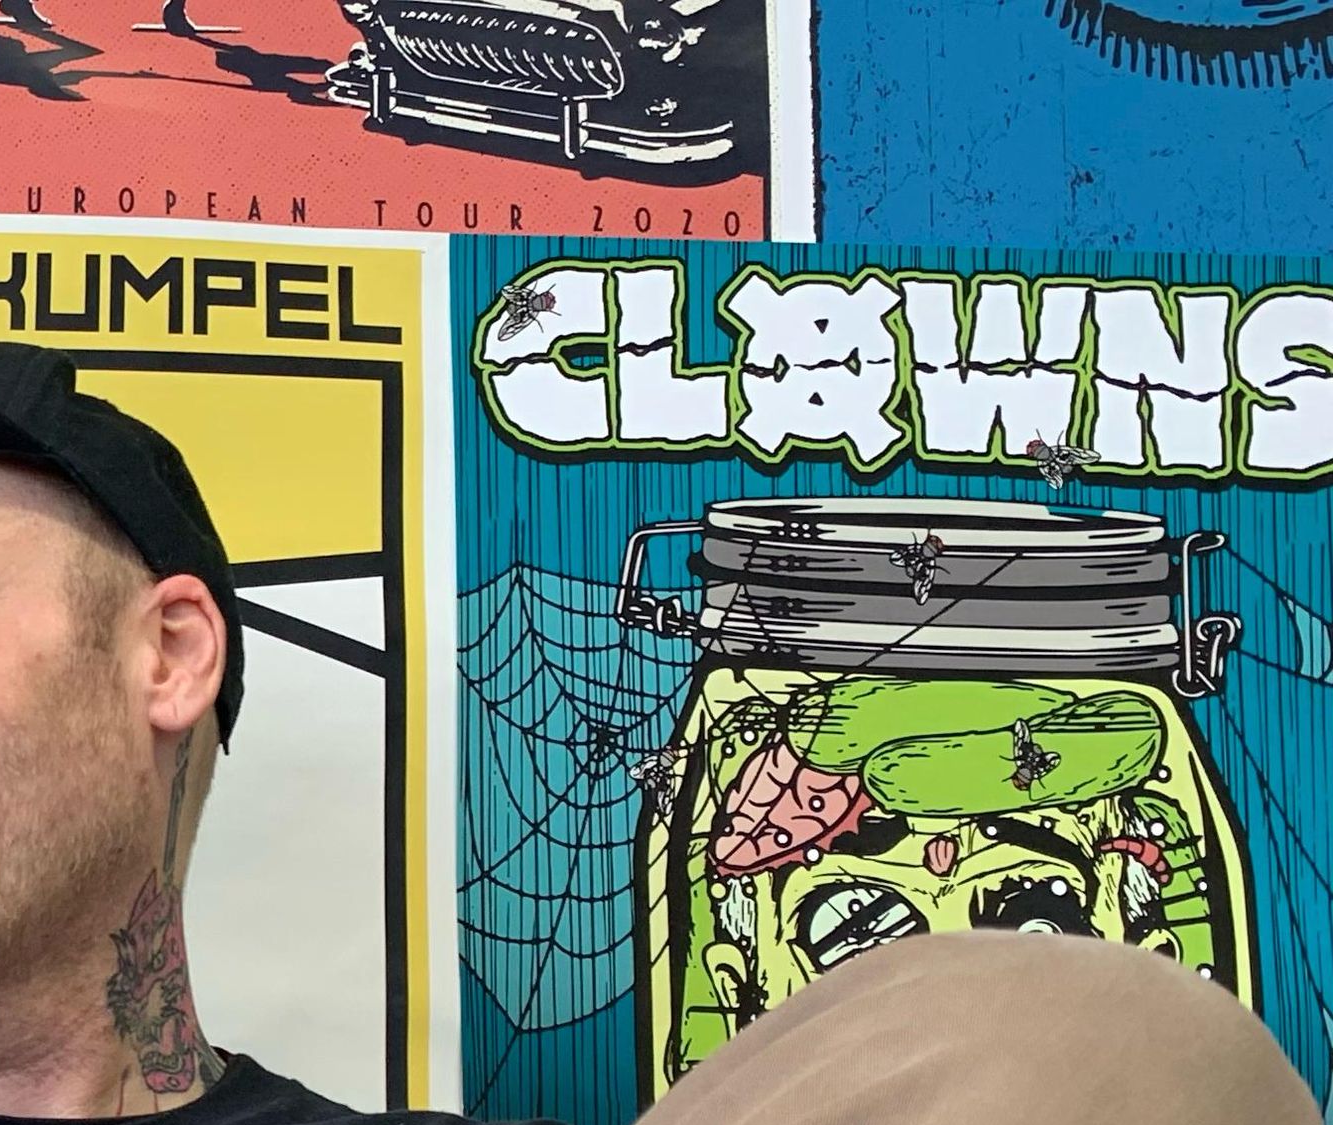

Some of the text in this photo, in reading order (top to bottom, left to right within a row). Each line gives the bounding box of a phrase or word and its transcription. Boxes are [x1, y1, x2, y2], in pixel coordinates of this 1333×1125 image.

[373, 199, 523, 231] TOUR
[592, 205, 741, 237] 2020
[474, 257, 1333, 483] CLOWNS
